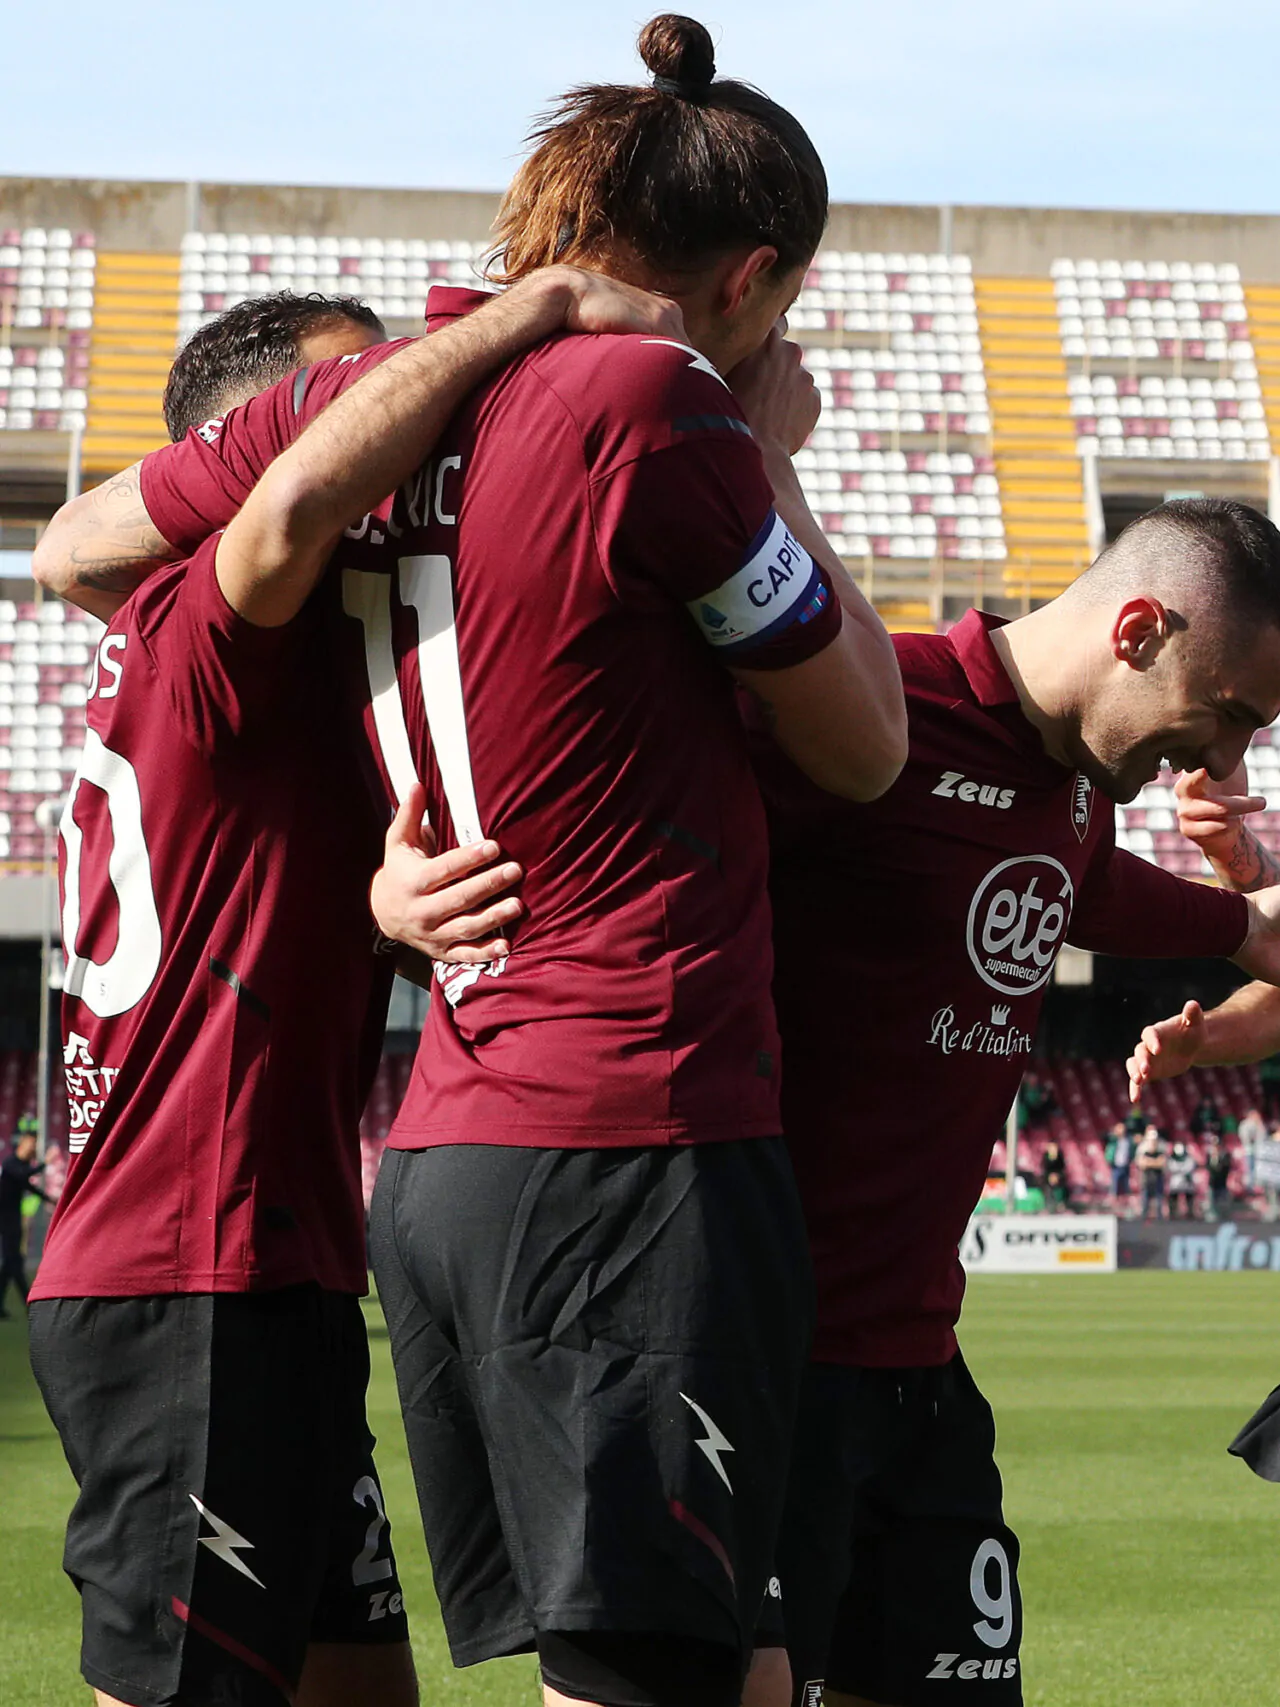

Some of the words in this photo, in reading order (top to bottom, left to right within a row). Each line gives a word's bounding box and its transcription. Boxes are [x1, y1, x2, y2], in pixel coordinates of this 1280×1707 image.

[747, 531, 802, 607] CAPIT
[342, 556, 485, 847] 11
[931, 771, 1016, 810] Zeus
[984, 957, 1042, 982] supermercati
[926, 1004, 960, 1055] Re
[970, 1538, 1013, 1649] 9
[926, 1653, 1017, 1680] Zeus
